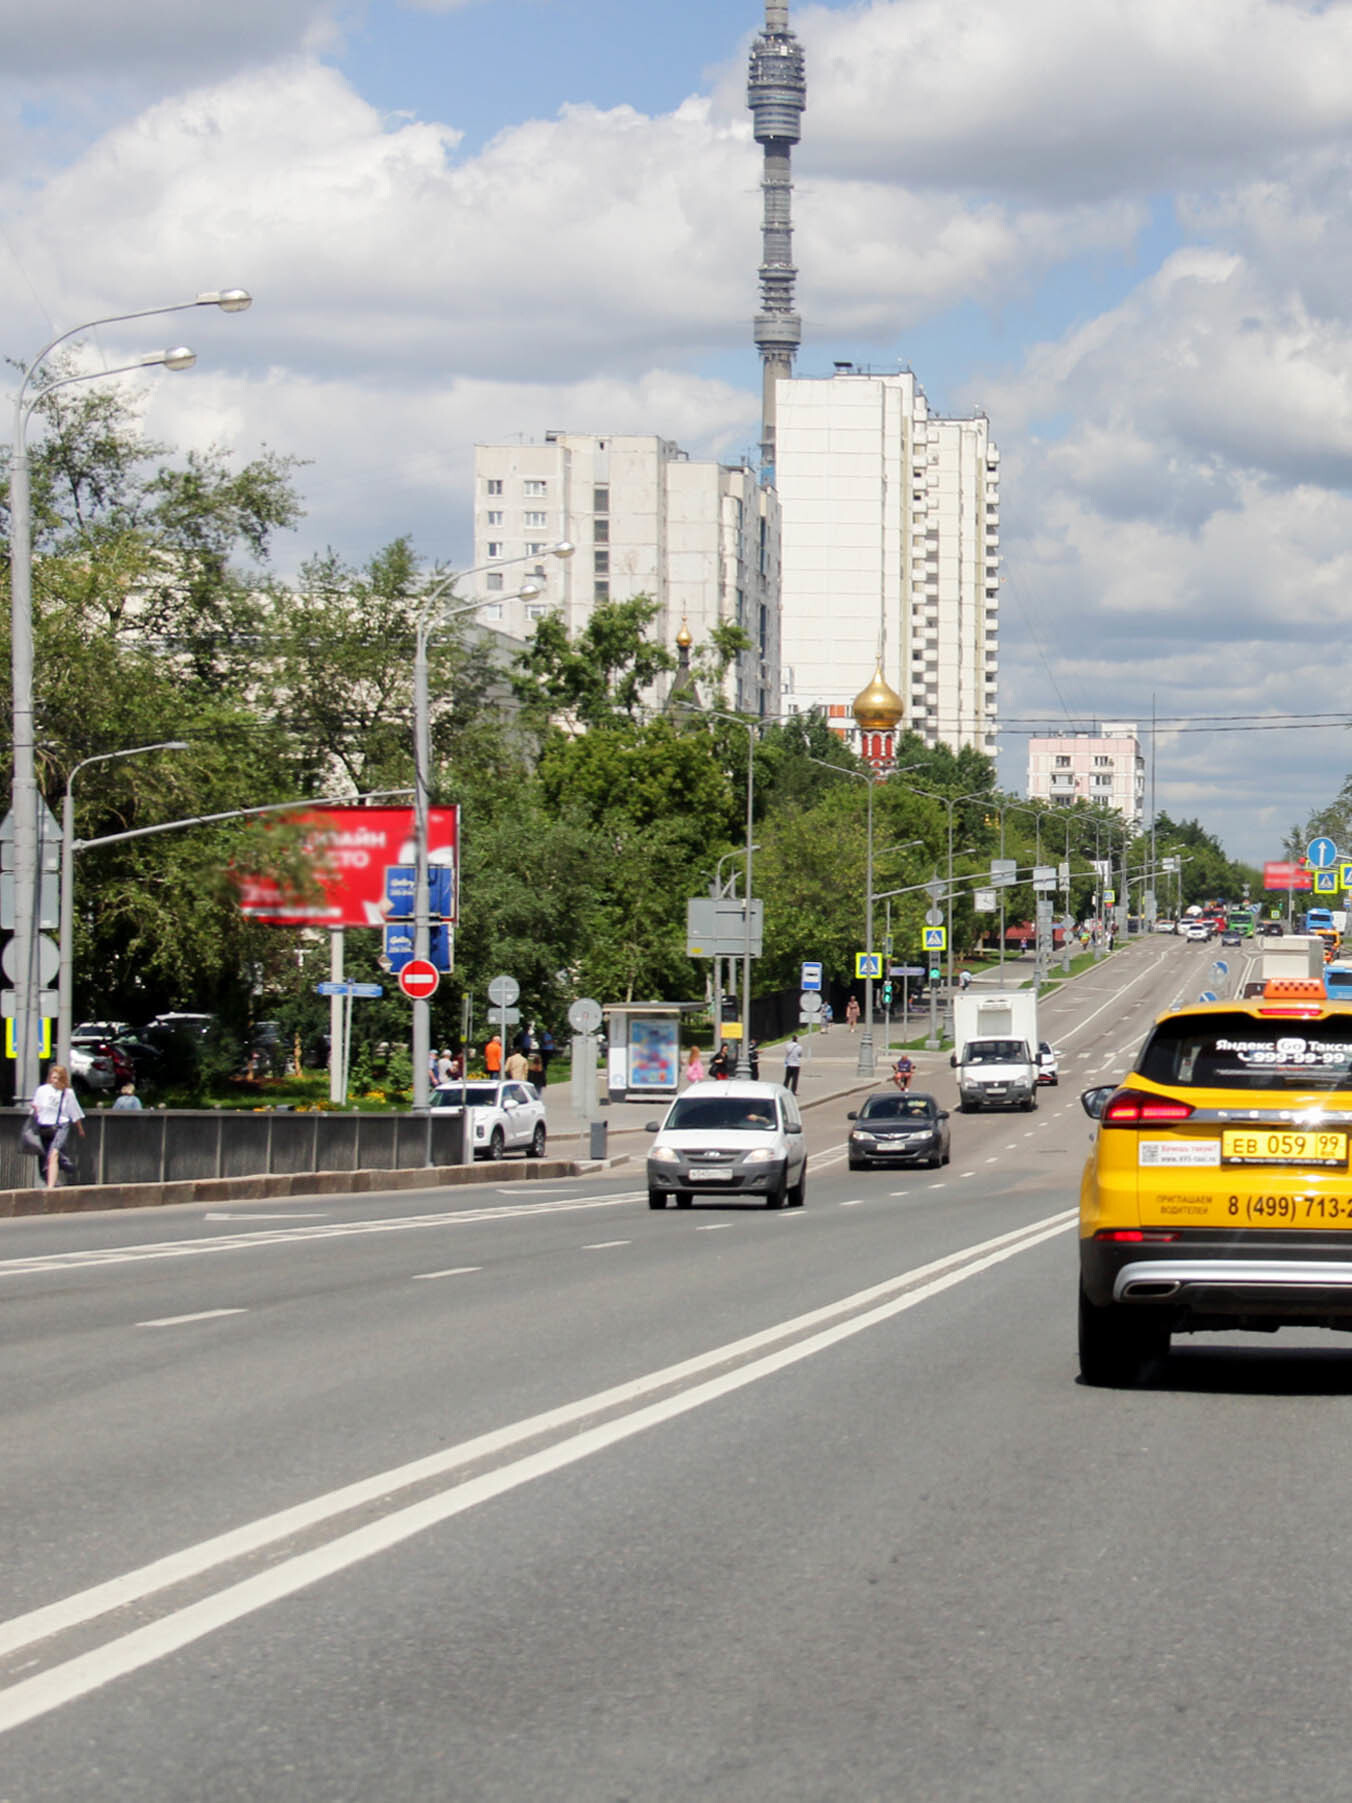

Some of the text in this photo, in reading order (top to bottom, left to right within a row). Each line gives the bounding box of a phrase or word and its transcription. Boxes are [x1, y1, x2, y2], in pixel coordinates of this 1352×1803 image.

[1215, 1039, 1275, 1052] Яндекс
[1253, 1052, 1345, 1064] 999-99-99
[1267, 1135, 1306, 1154] 059
[1318, 1136, 1339, 1151] 99
[1228, 1195, 1239, 1215] 8
[1246, 1196, 1297, 1222] (499)
